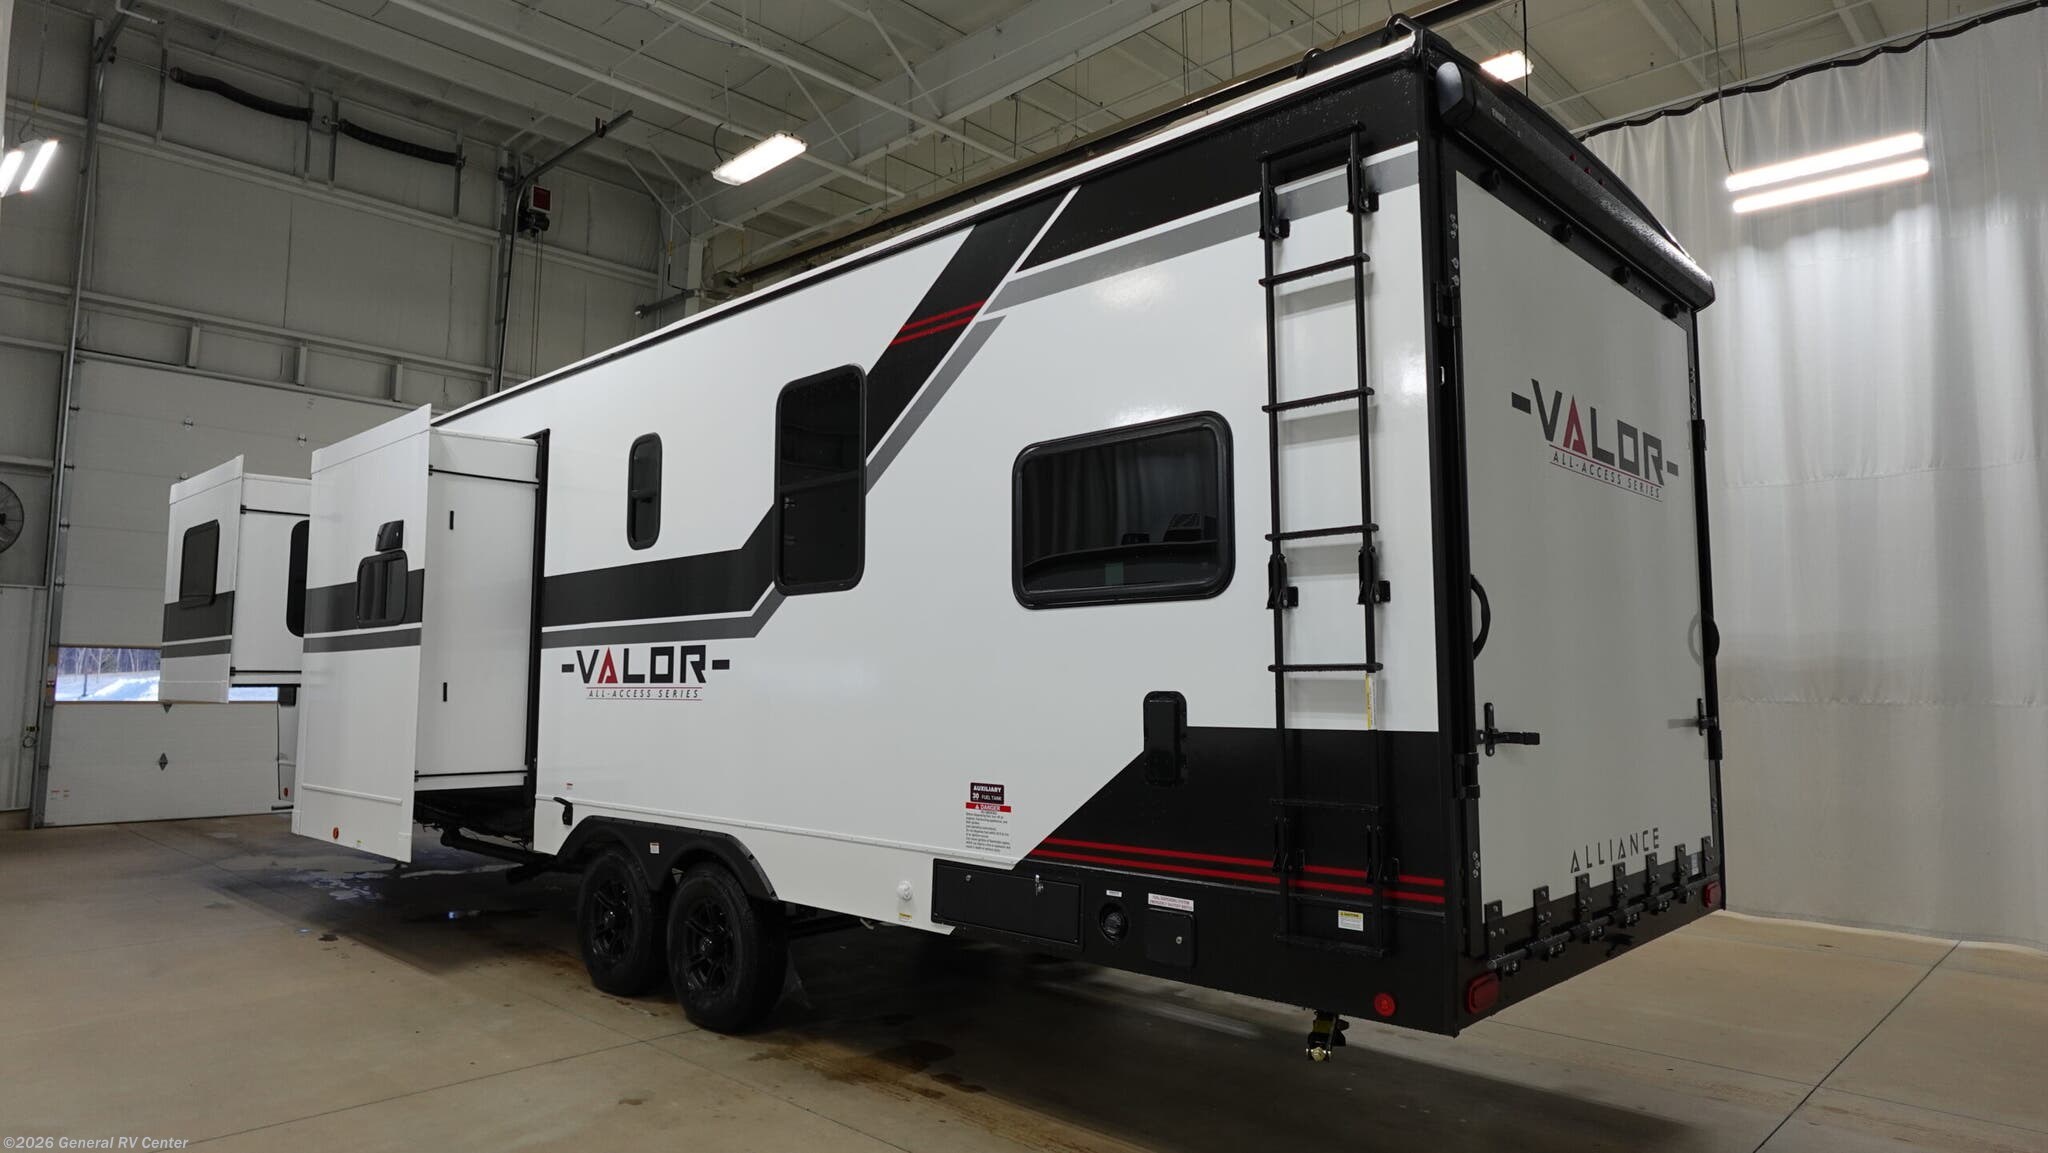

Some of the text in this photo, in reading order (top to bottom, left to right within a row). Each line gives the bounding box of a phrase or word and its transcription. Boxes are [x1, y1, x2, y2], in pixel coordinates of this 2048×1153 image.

[1553, 452, 1660, 498] ALL-ACCESS SERIES
[589, 689, 699, 698] ALL-ACCESS SERIES
[973, 785, 1002, 793] AUXILIARY
[1570, 827, 1660, 874] ALLIANCE
